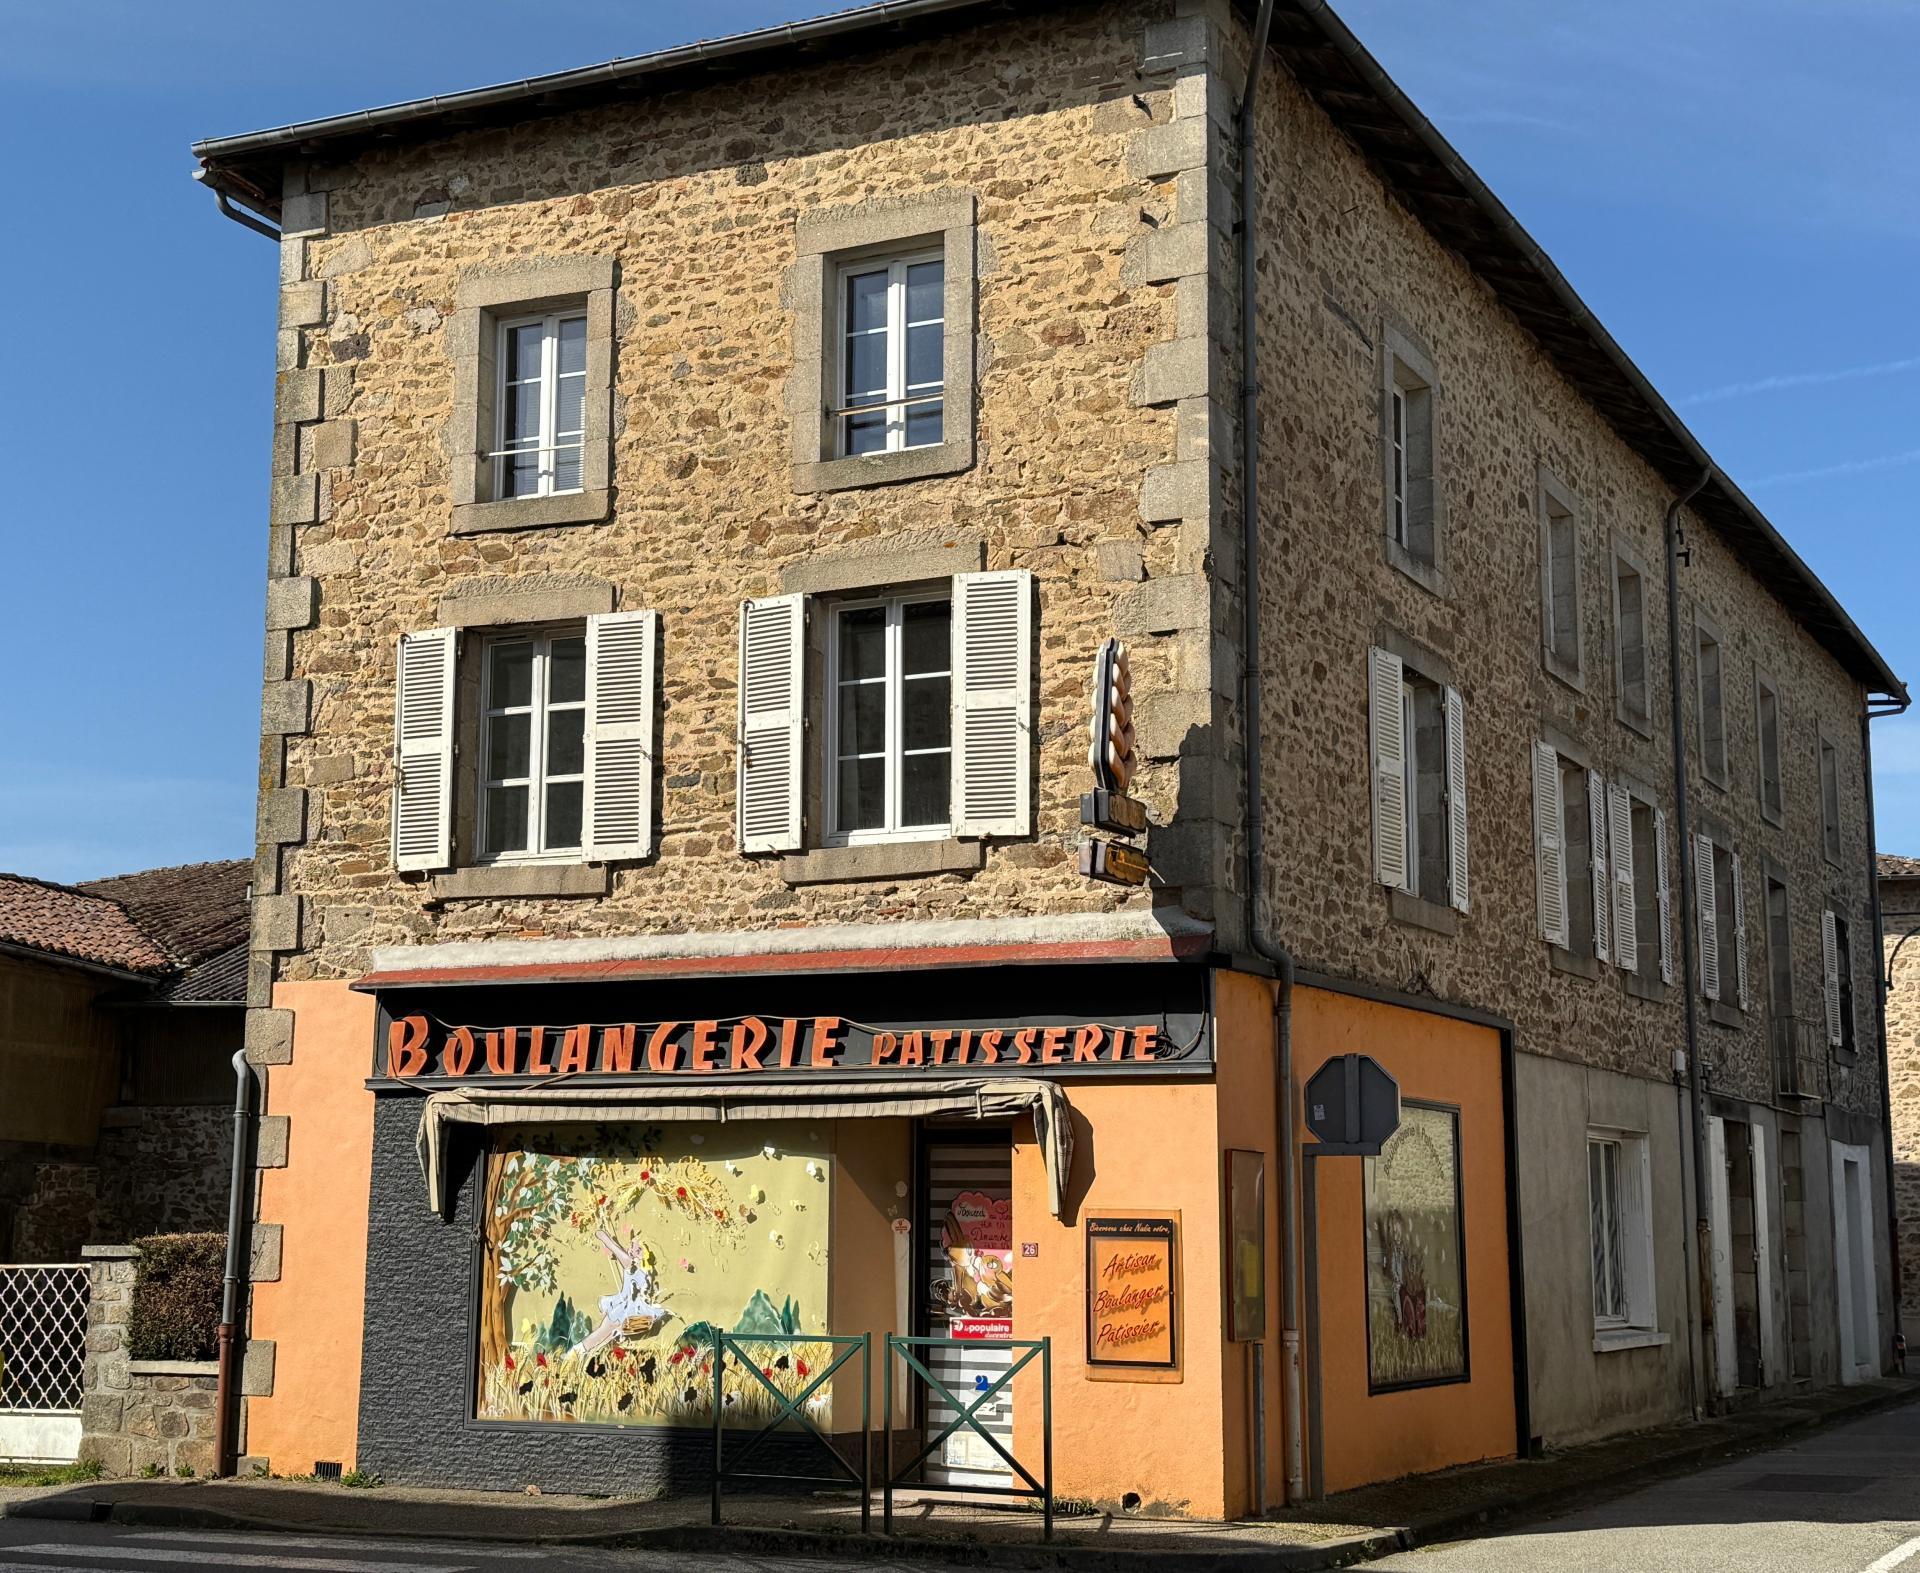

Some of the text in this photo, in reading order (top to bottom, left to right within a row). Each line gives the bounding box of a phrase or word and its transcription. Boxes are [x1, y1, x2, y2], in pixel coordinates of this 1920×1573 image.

[387, 1015, 1158, 1077] BOULANGERIE PATISSERIE
[1025, 1245, 1035, 1254] 26
[1102, 1253, 1156, 1278] Artisan
[1093, 1284, 1164, 1312] Boulanger
[969, 1323, 1010, 1333] populaire
[1097, 1318, 1160, 1345] Patissier
